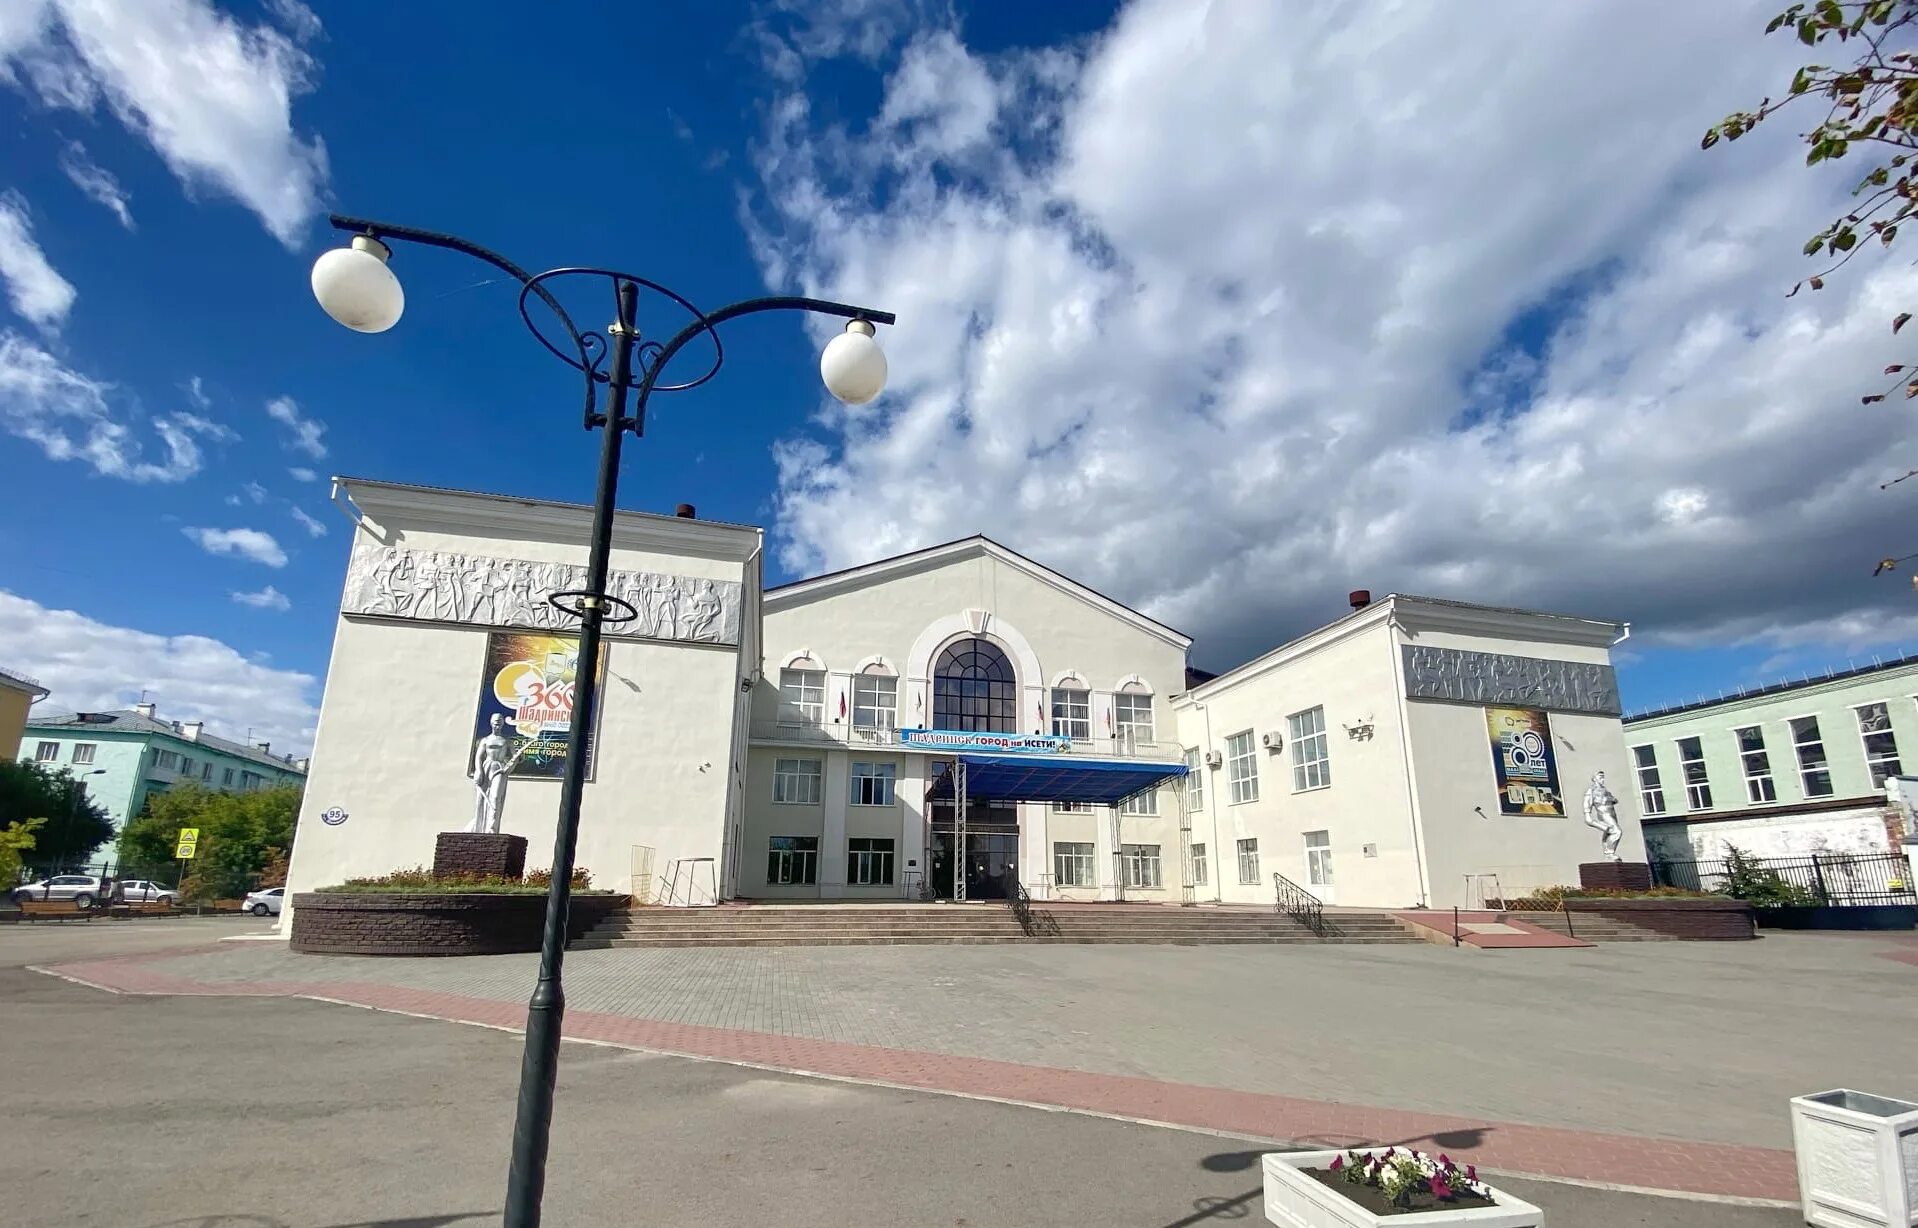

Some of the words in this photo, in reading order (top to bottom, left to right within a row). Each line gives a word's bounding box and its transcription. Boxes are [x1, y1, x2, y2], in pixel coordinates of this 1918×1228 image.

[975, 737, 1009, 748] ГОРОД
[1011, 740, 1022, 748] на
[1024, 739, 1056, 749] ИСЕТИ!
[1530, 759, 1545, 767] лет
[329, 810, 341, 818] 95
